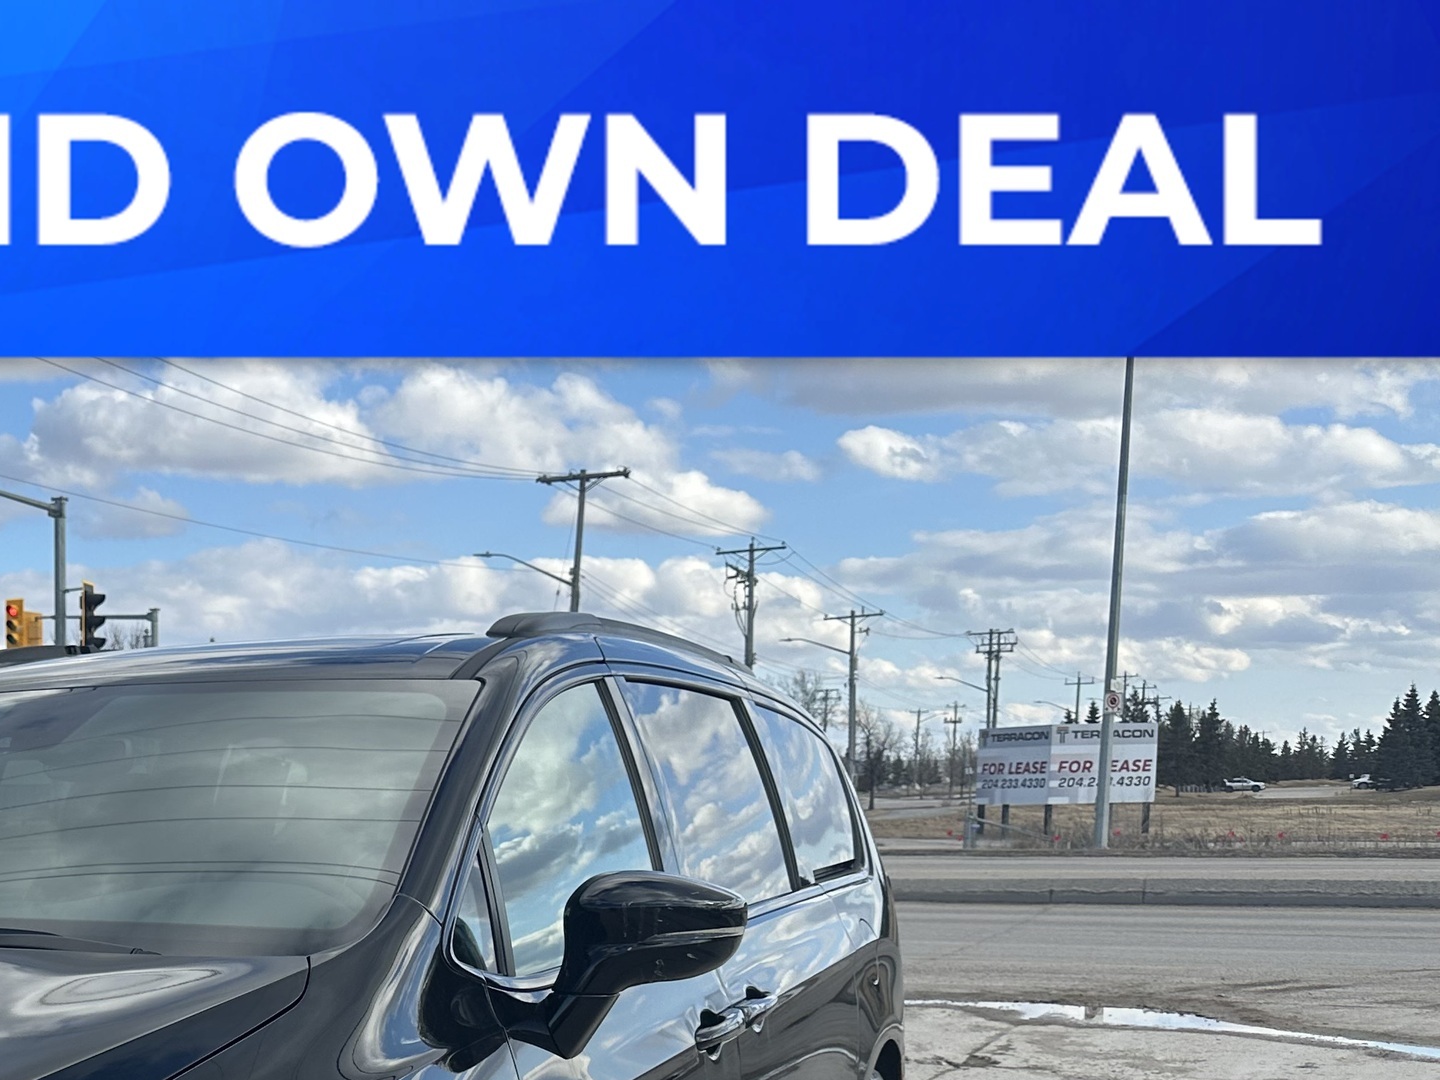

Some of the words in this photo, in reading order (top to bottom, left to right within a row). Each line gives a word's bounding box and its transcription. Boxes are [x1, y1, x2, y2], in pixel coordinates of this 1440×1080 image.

[990, 731, 1049, 743] TERRACON
[1071, 729, 1154, 739] TERACON
[982, 762, 1004, 775] FOR
[1008, 761, 1047, 775] LEASE
[1058, 760, 1093, 774] FOR
[1110, 759, 1153, 772] EASE
[981, 777, 1047, 789] 204.233.4330
